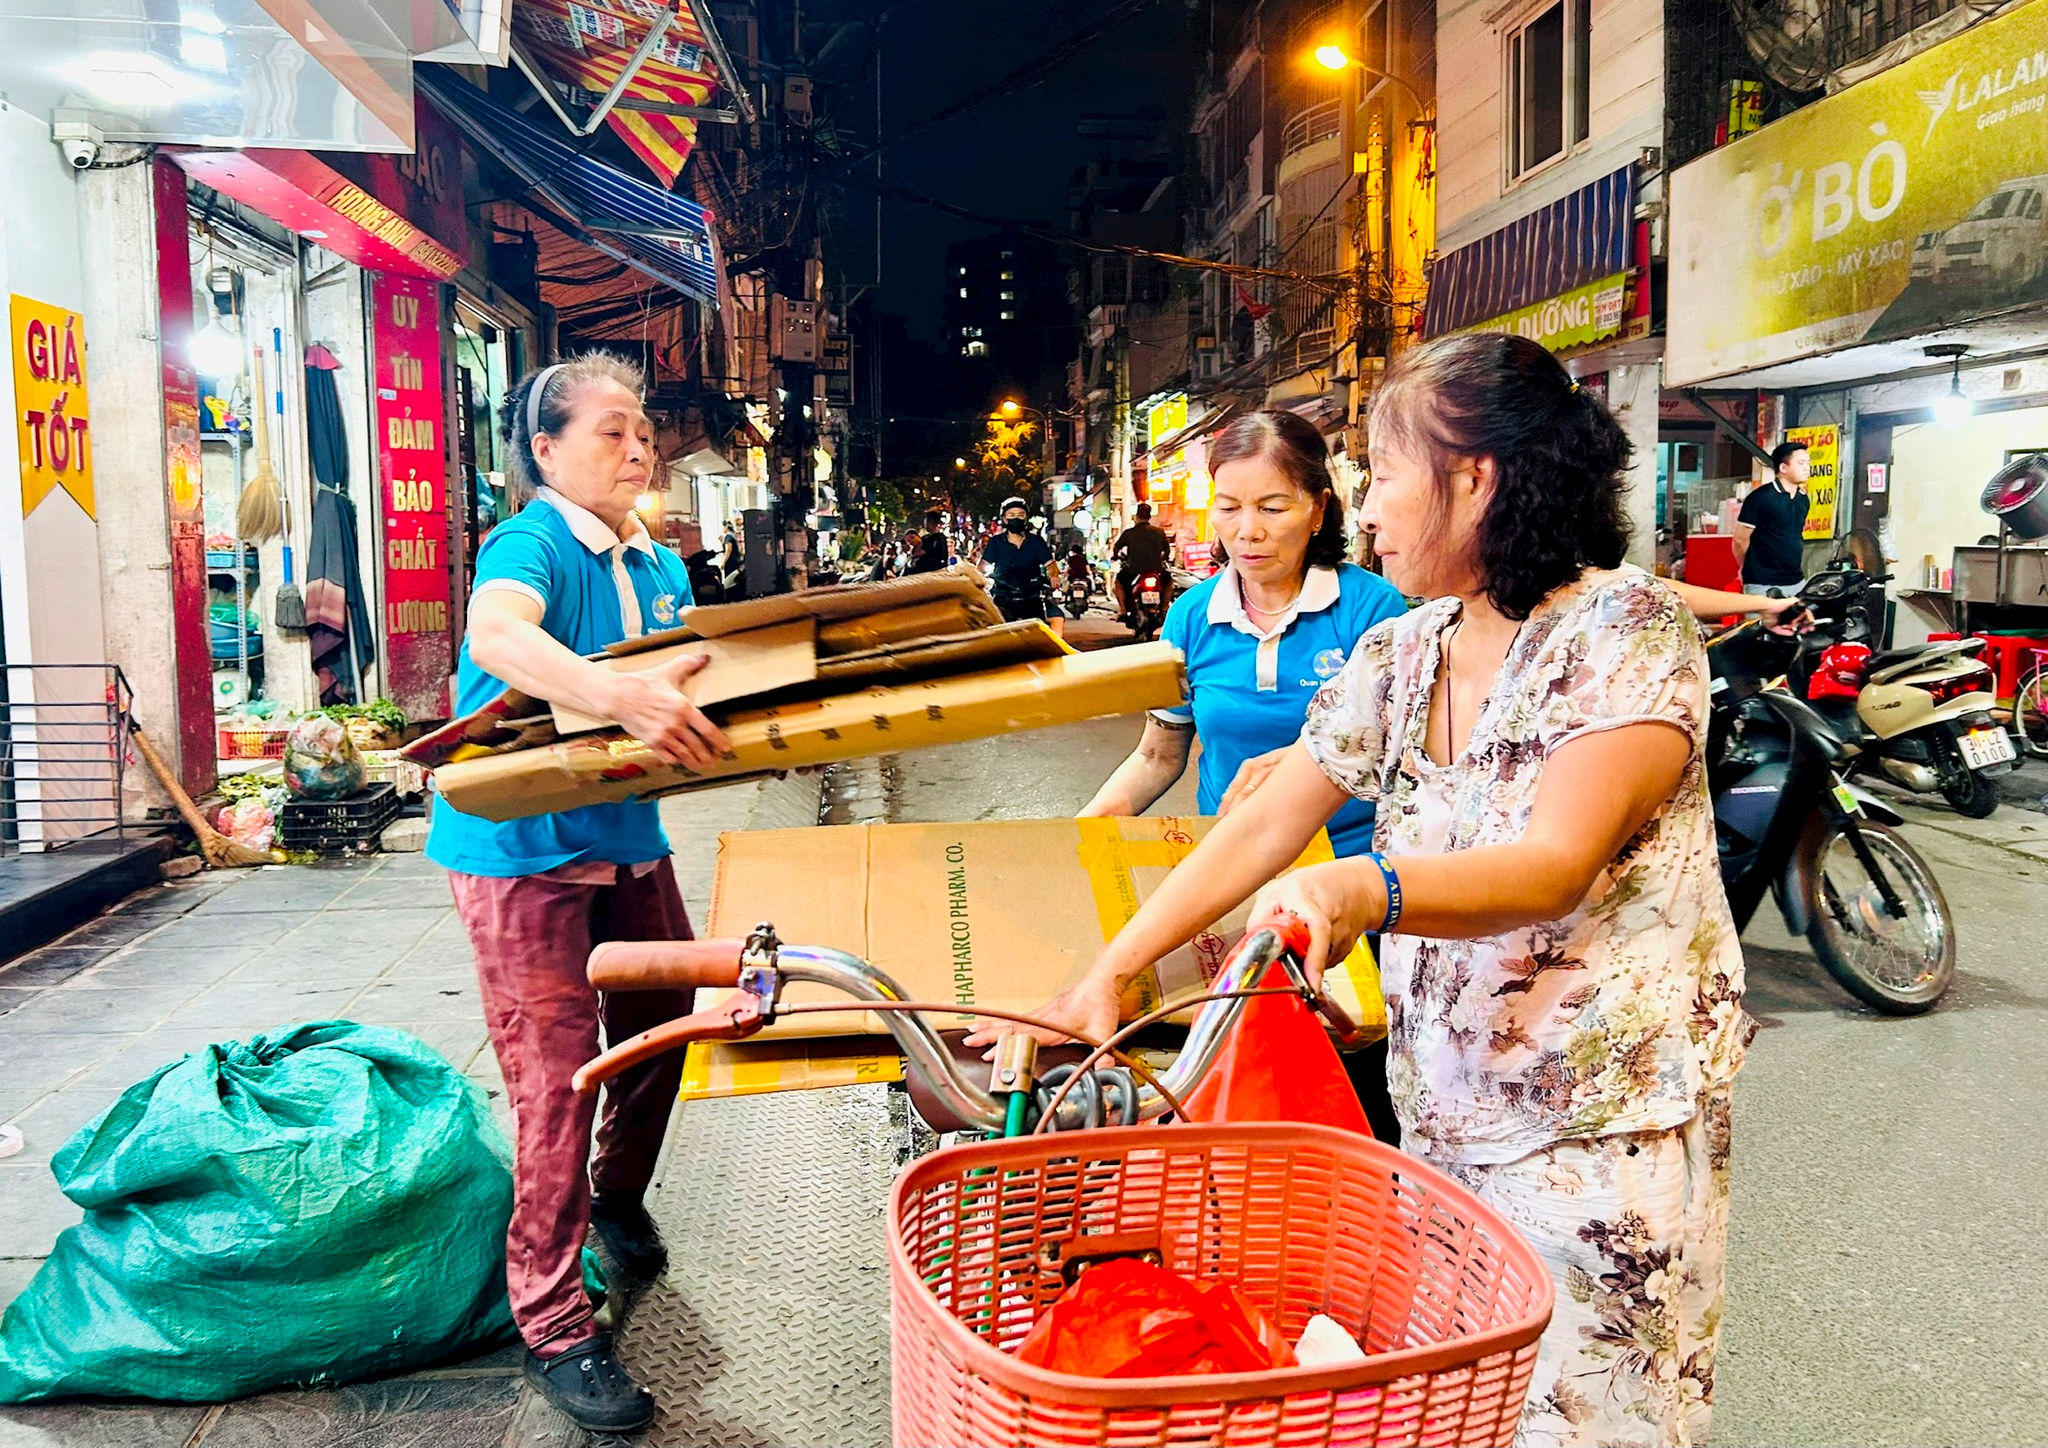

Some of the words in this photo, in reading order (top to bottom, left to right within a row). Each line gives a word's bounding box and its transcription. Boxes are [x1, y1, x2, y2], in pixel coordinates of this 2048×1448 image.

[1812, 121, 1907, 242] BÒ
[325, 183, 390, 234] HOÀNG
[374, 216, 415, 248] ANH
[26, 315, 82, 386] GIÁ
[391, 351, 423, 391] TÍN
[25, 391, 88, 473] TỐT
[388, 406, 435, 451] ĐẢM
[392, 468, 433, 512] BẢO
[388, 526, 437, 570] CHẤT
[388, 599, 447, 637] LƯỢNG
[1299, 679, 1318, 688] Quan
[1972, 746, 2008, 765] 0100
[945, 842, 965, 863] CO.
[948, 866, 969, 918] PHARM.
